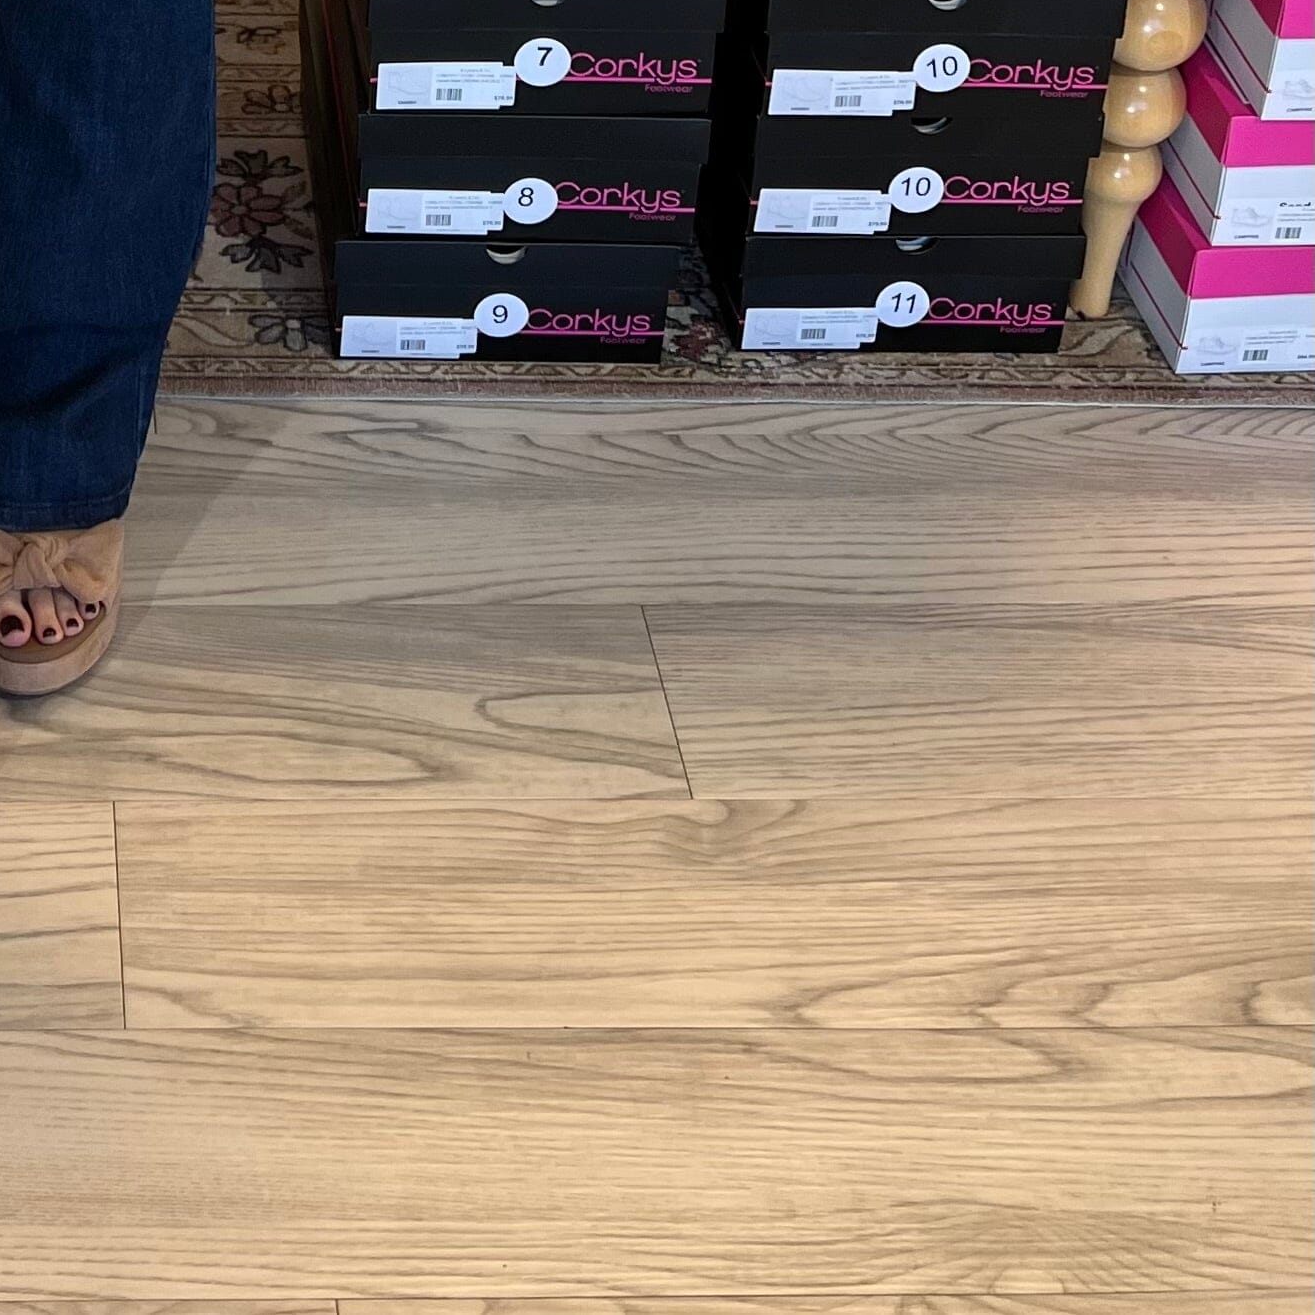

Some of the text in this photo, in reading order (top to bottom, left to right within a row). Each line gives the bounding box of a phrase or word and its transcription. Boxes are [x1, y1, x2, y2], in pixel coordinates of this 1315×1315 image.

[537, 46, 553, 67] 7
[926, 55, 959, 79] 10
[570, 52, 698, 85] Corkys
[967, 58, 1094, 91] Corkys
[644, 83, 693, 94] Footwear
[1040, 89, 1089, 99] Footwear
[517, 186, 534, 207] 8
[554, 181, 681, 213] Corkys
[900, 176, 931, 197] 10
[944, 175, 1070, 206] Corkys
[491, 304, 509, 324] 9
[890, 291, 918, 314] 11
[928, 297, 1053, 327] Corkys
[527, 308, 650, 338] Corkys
